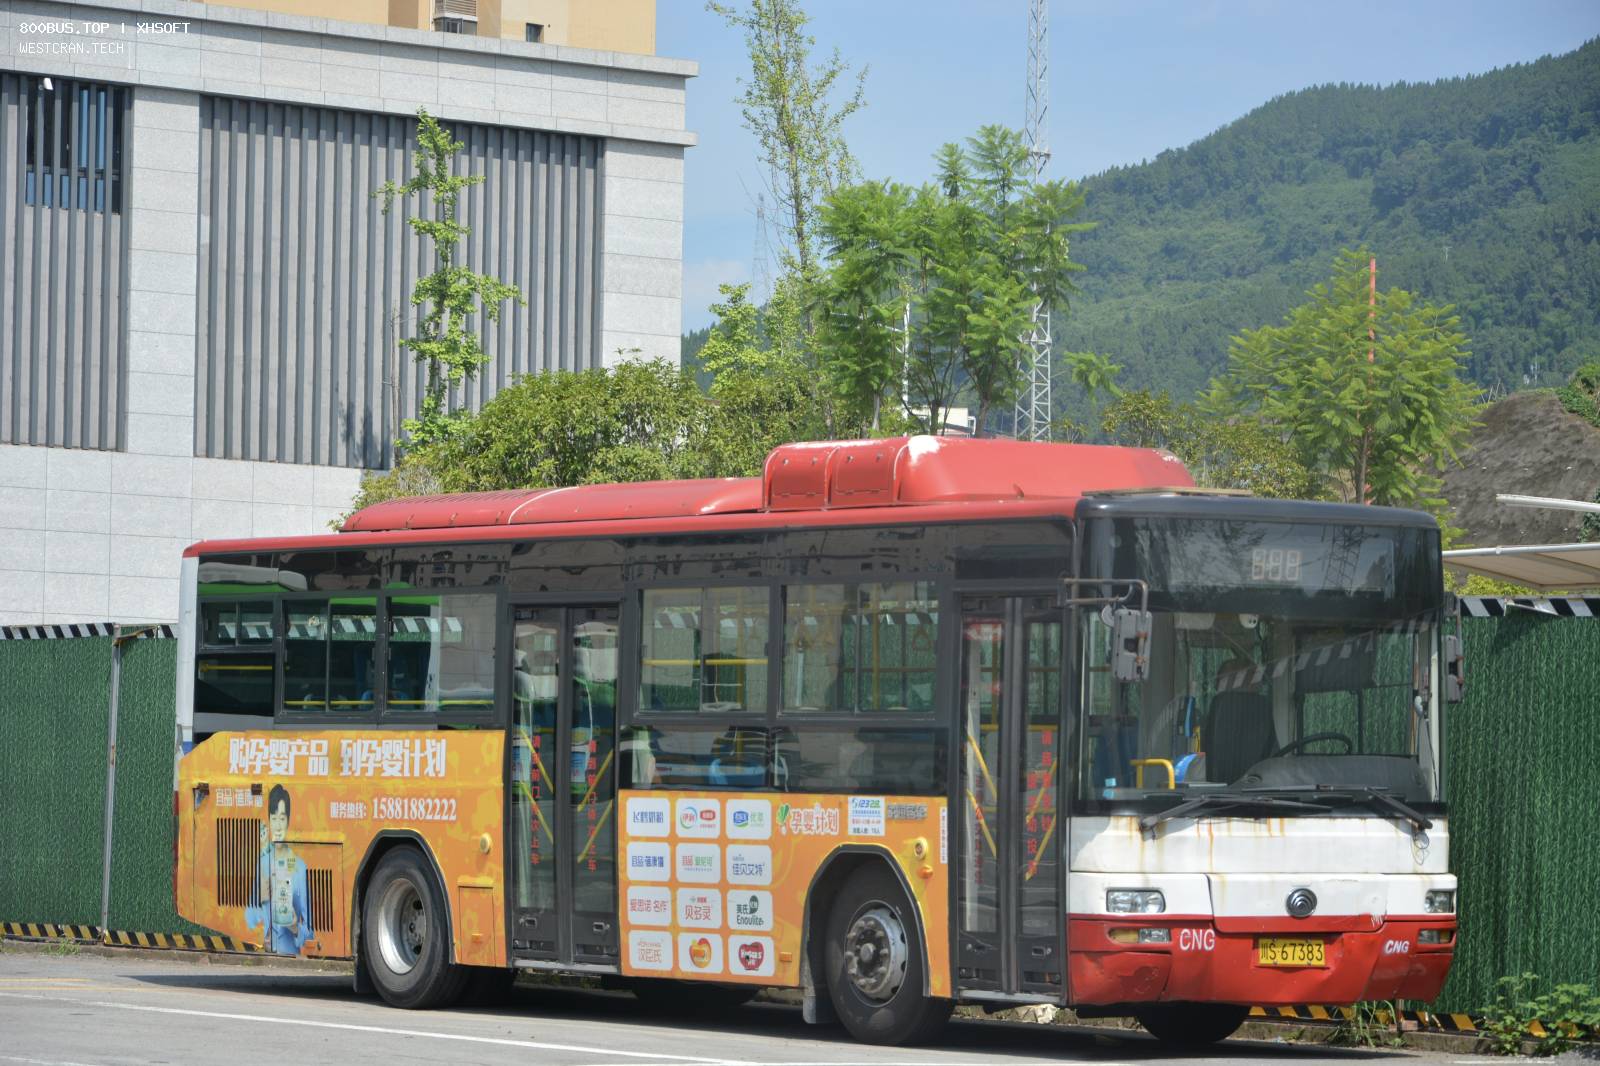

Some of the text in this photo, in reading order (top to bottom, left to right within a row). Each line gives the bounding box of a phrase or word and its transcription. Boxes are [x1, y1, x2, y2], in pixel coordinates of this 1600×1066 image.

[228, 738, 447, 777] 购孕婴产品 到孕婴计划
[373, 797, 457, 821] 15881882222
[791, 807, 839, 834] 孕婴计划
[732, 863, 763, 877] 佳贝艾特
[685, 904, 713, 921] 贝多灵
[1179, 928, 1215, 951] CNG
[1384, 940, 1410, 954] CNG
